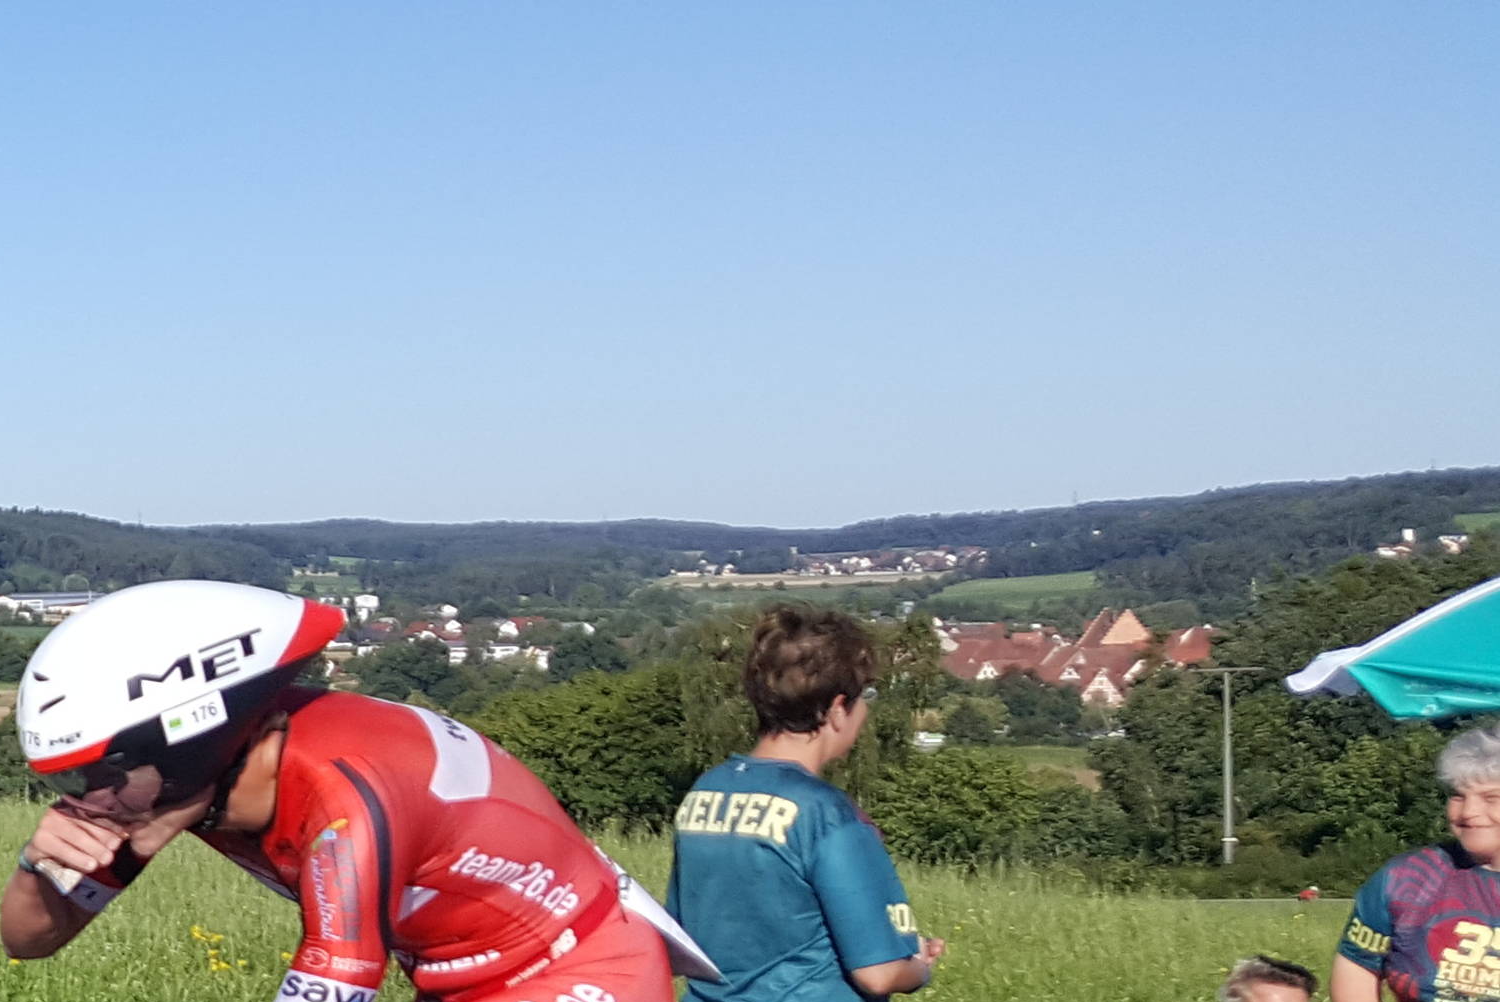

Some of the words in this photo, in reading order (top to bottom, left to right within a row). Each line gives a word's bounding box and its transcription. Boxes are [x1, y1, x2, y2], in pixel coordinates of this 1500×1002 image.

[126, 627, 262, 702] MET
[190, 702, 218, 723] 176
[450, 846, 580, 916] team26.de
